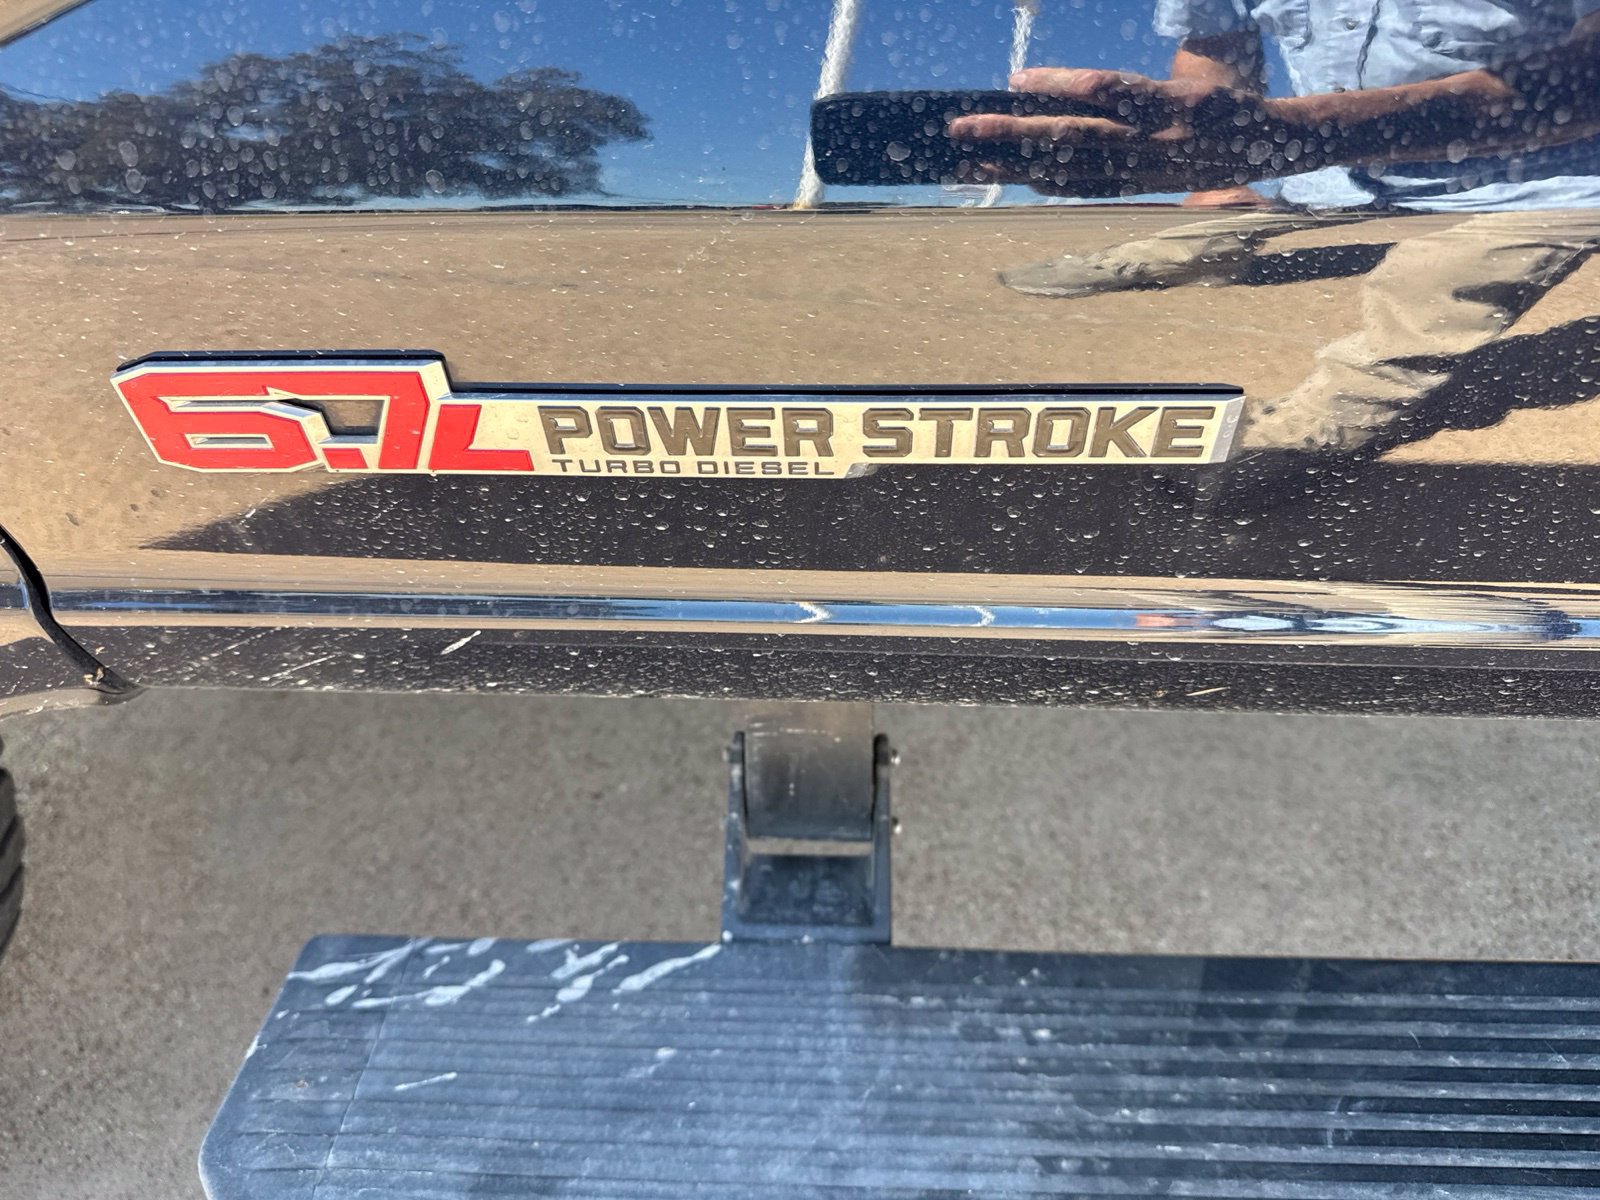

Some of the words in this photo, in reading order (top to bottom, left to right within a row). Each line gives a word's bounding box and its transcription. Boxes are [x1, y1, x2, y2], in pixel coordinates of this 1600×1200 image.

[116, 371, 535, 471] 6.7L
[537, 405, 834, 458] POWER
[862, 406, 1216, 458] STROKE
[551, 458, 681, 474] TURBO
[697, 460, 834, 475] DIESEL
